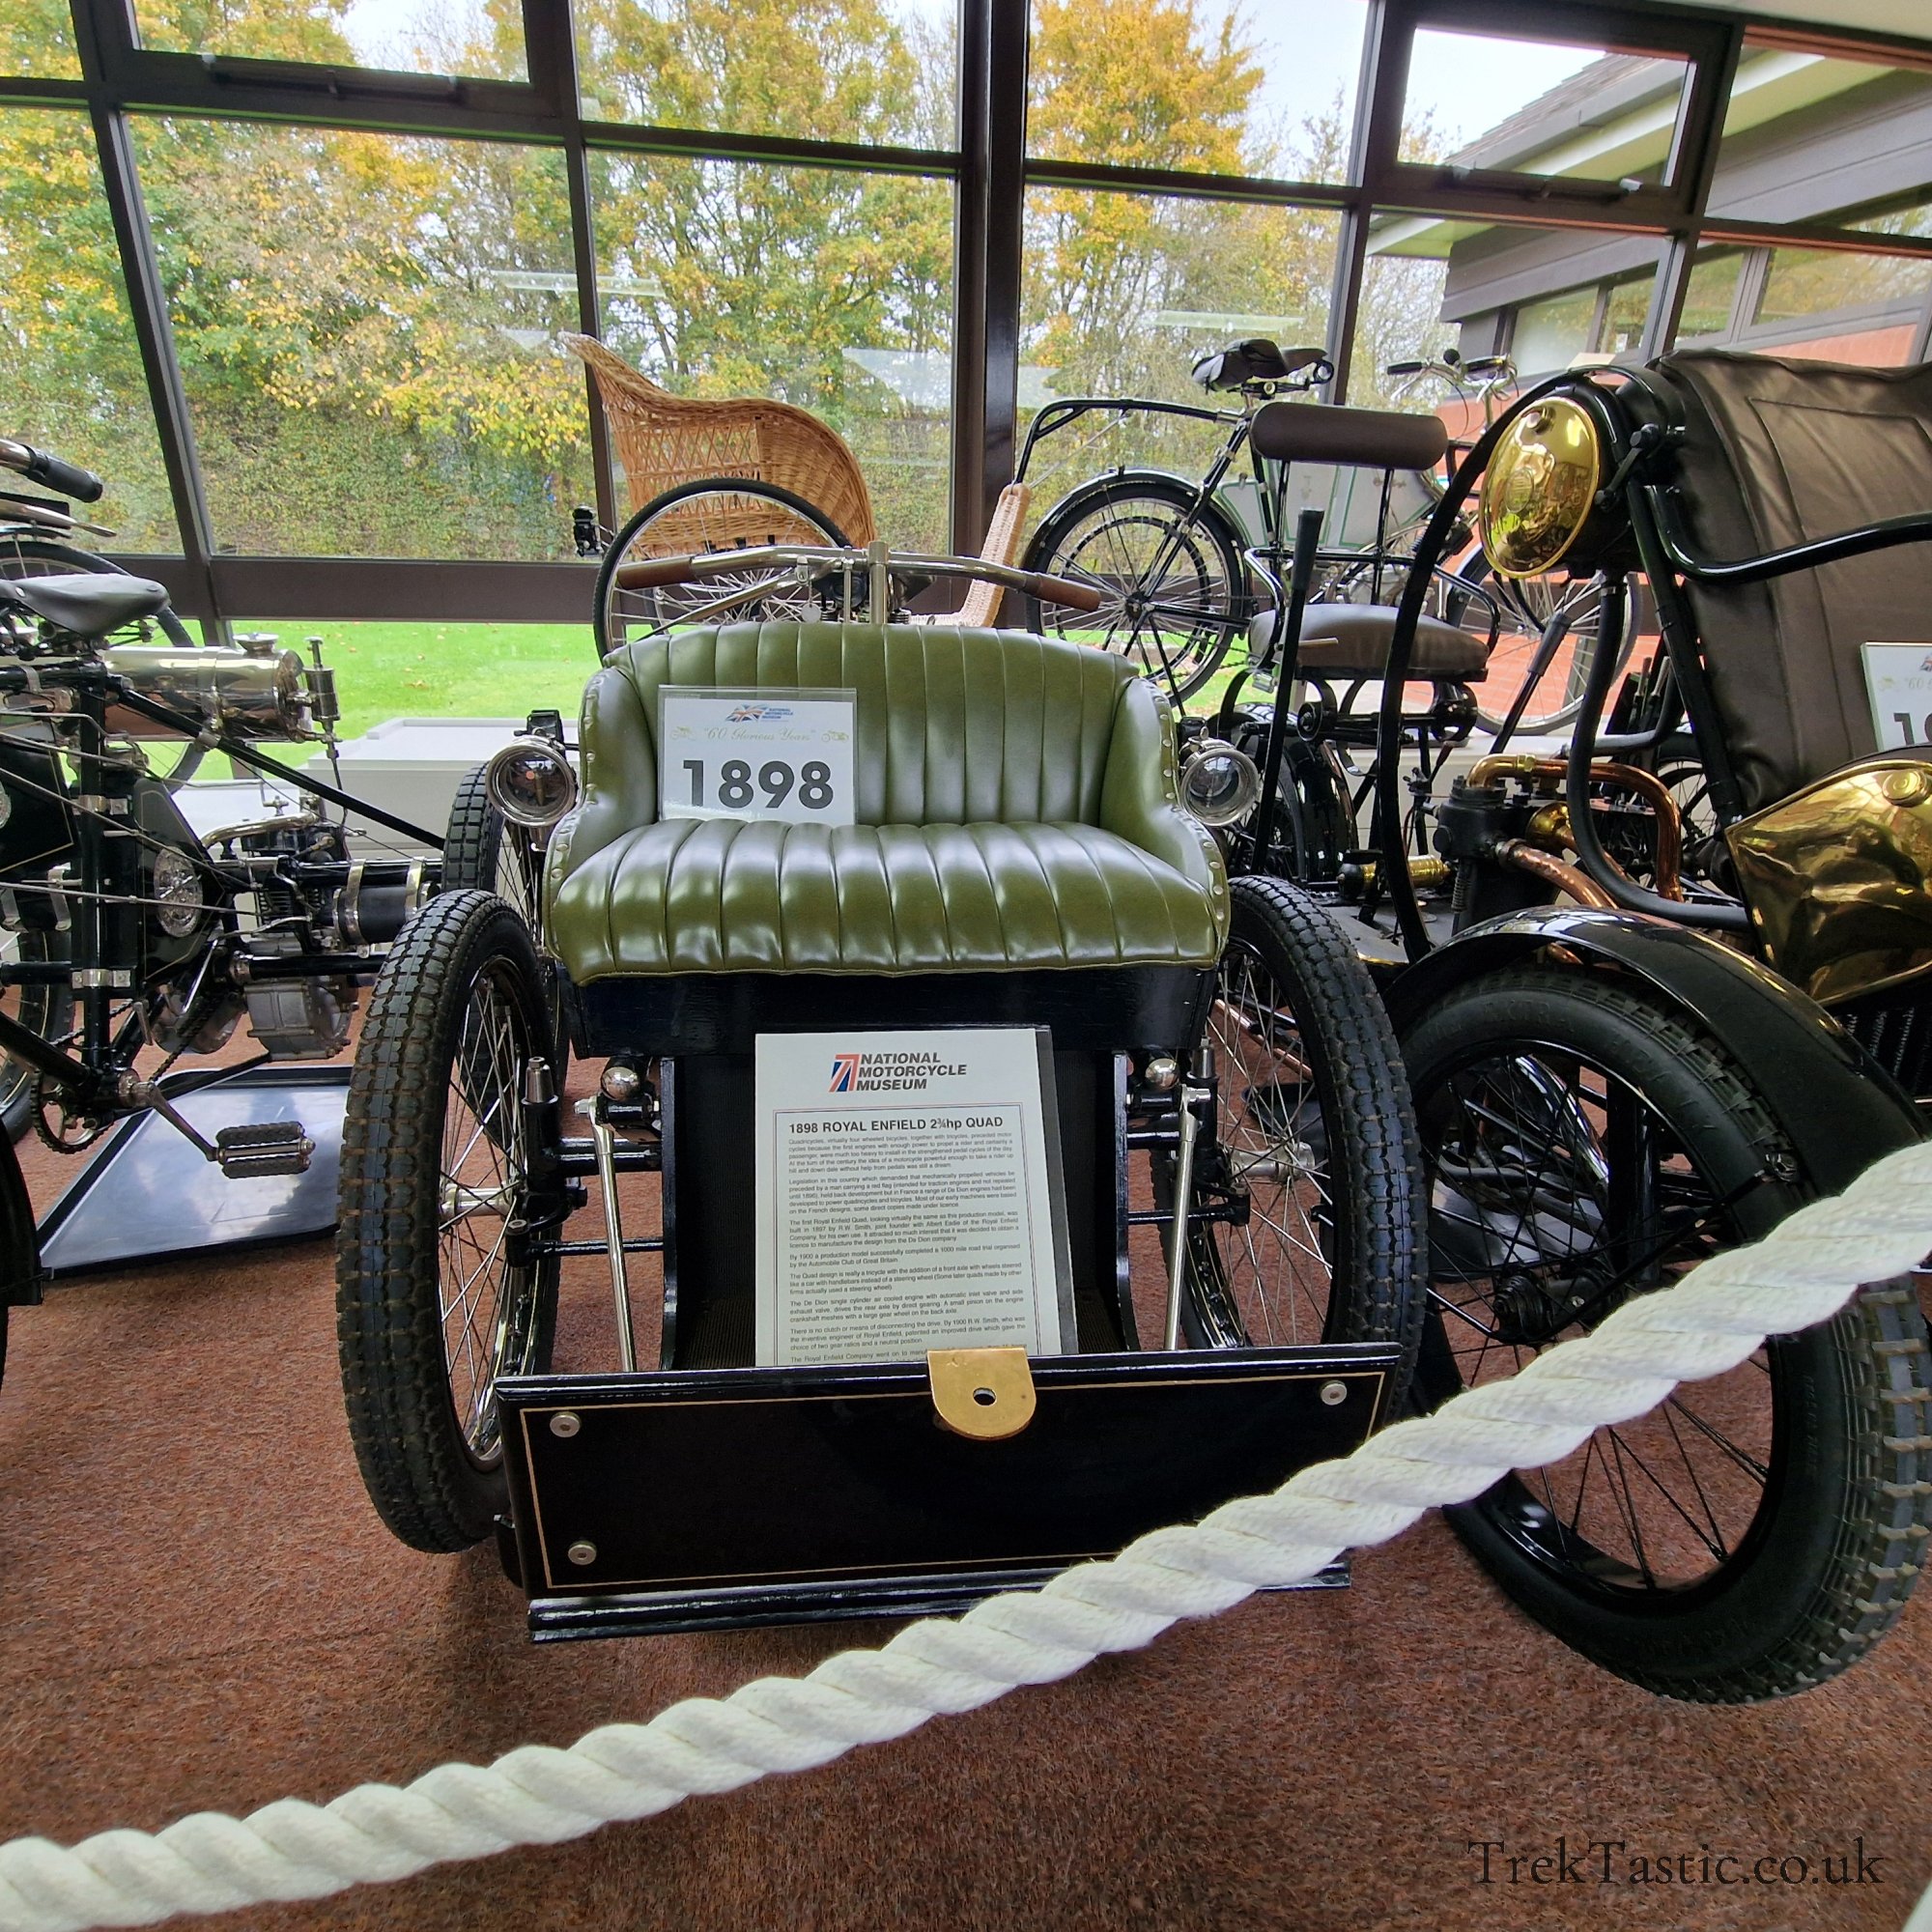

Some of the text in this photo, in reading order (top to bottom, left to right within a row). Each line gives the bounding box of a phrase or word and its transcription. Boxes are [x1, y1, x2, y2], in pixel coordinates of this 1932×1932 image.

[731, 727, 776, 741] Glorious
[683, 759, 834, 810] 1898
[860, 1052, 941, 1065] NATIONAL
[858, 1064, 967, 1078] MOTORCYCLE
[856, 1078, 927, 1091] MUSEUM
[789, 1122, 818, 1134] 1898
[822, 1120, 867, 1133] ROYAL
[871, 1119, 926, 1131] ENFIELD
[966, 1116, 1003, 1128] QUAD
